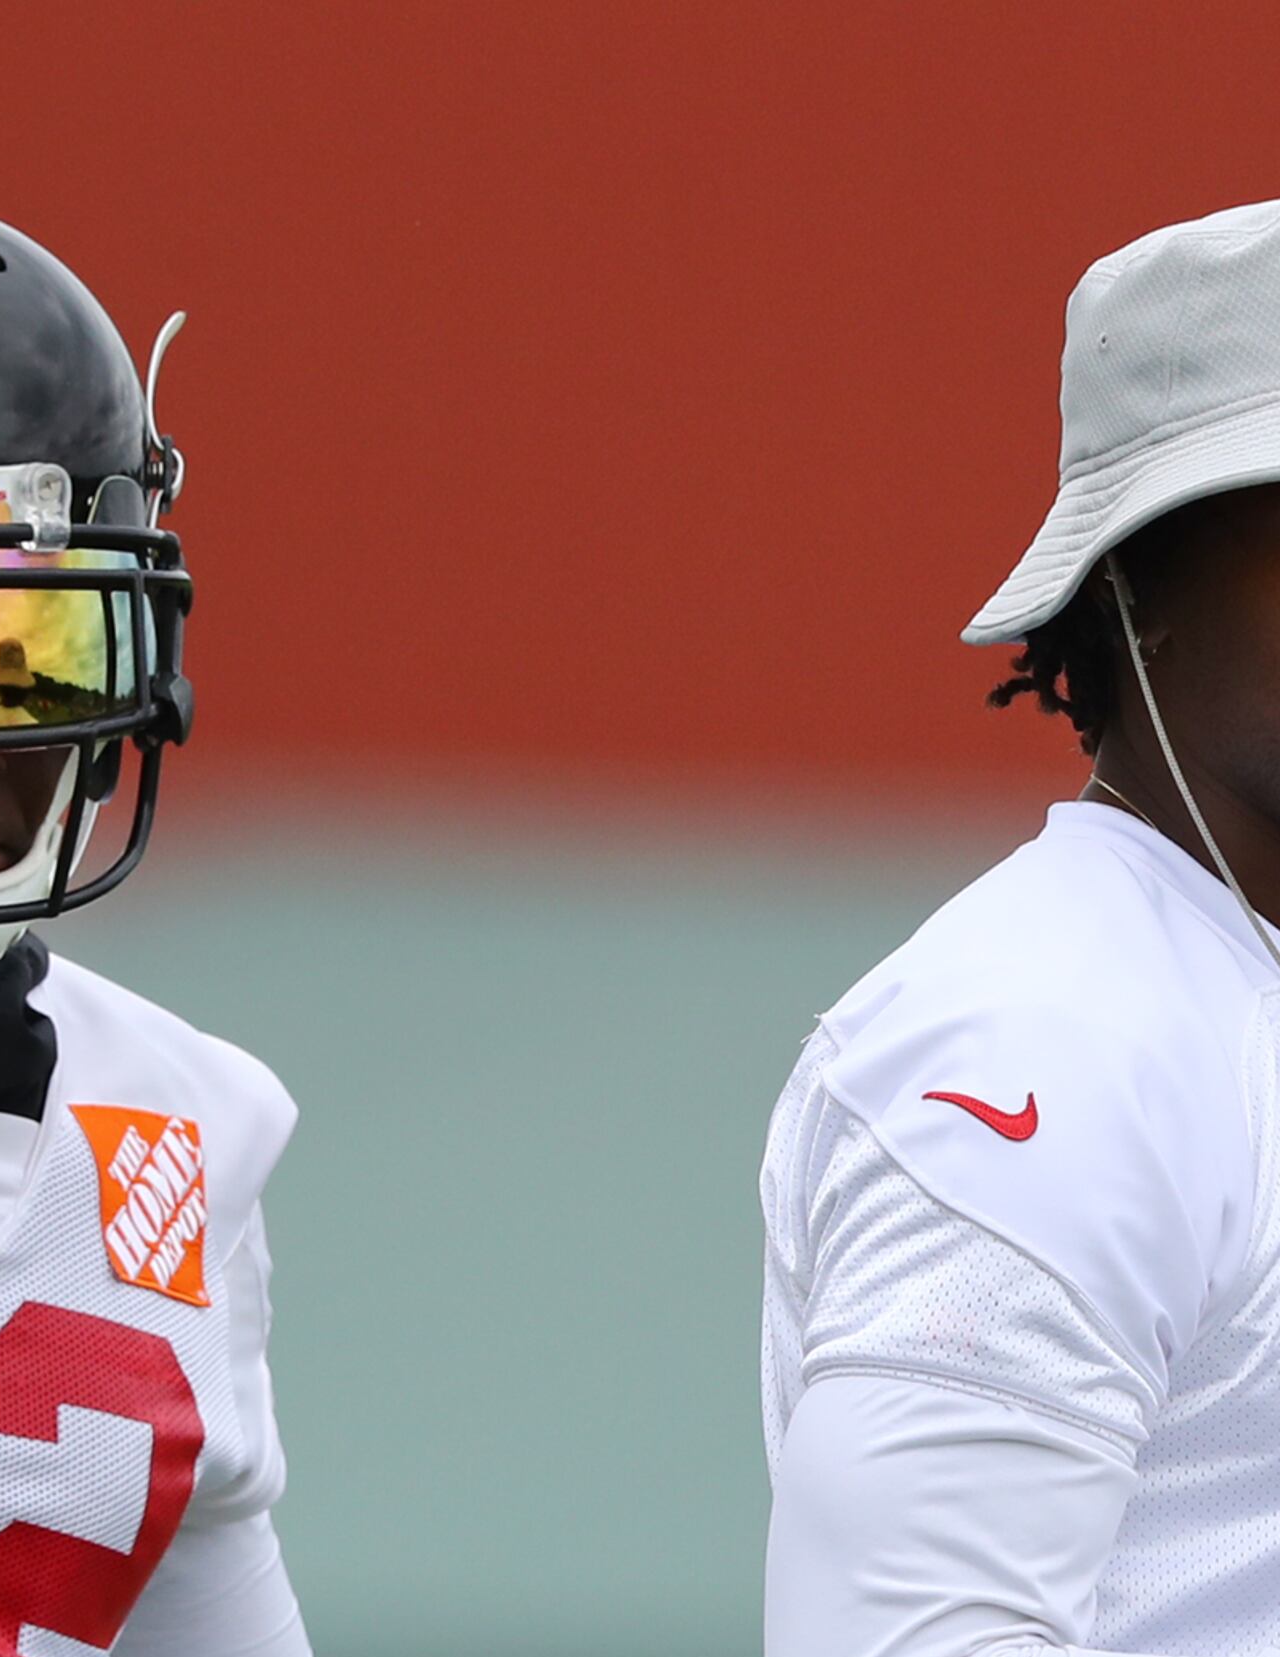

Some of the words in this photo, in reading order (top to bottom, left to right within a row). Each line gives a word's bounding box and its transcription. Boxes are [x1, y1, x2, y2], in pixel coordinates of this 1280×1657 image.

[105, 1117, 203, 1281] HOME
[107, 1124, 150, 1191] THE
[149, 1187, 208, 1288] DEPOT
